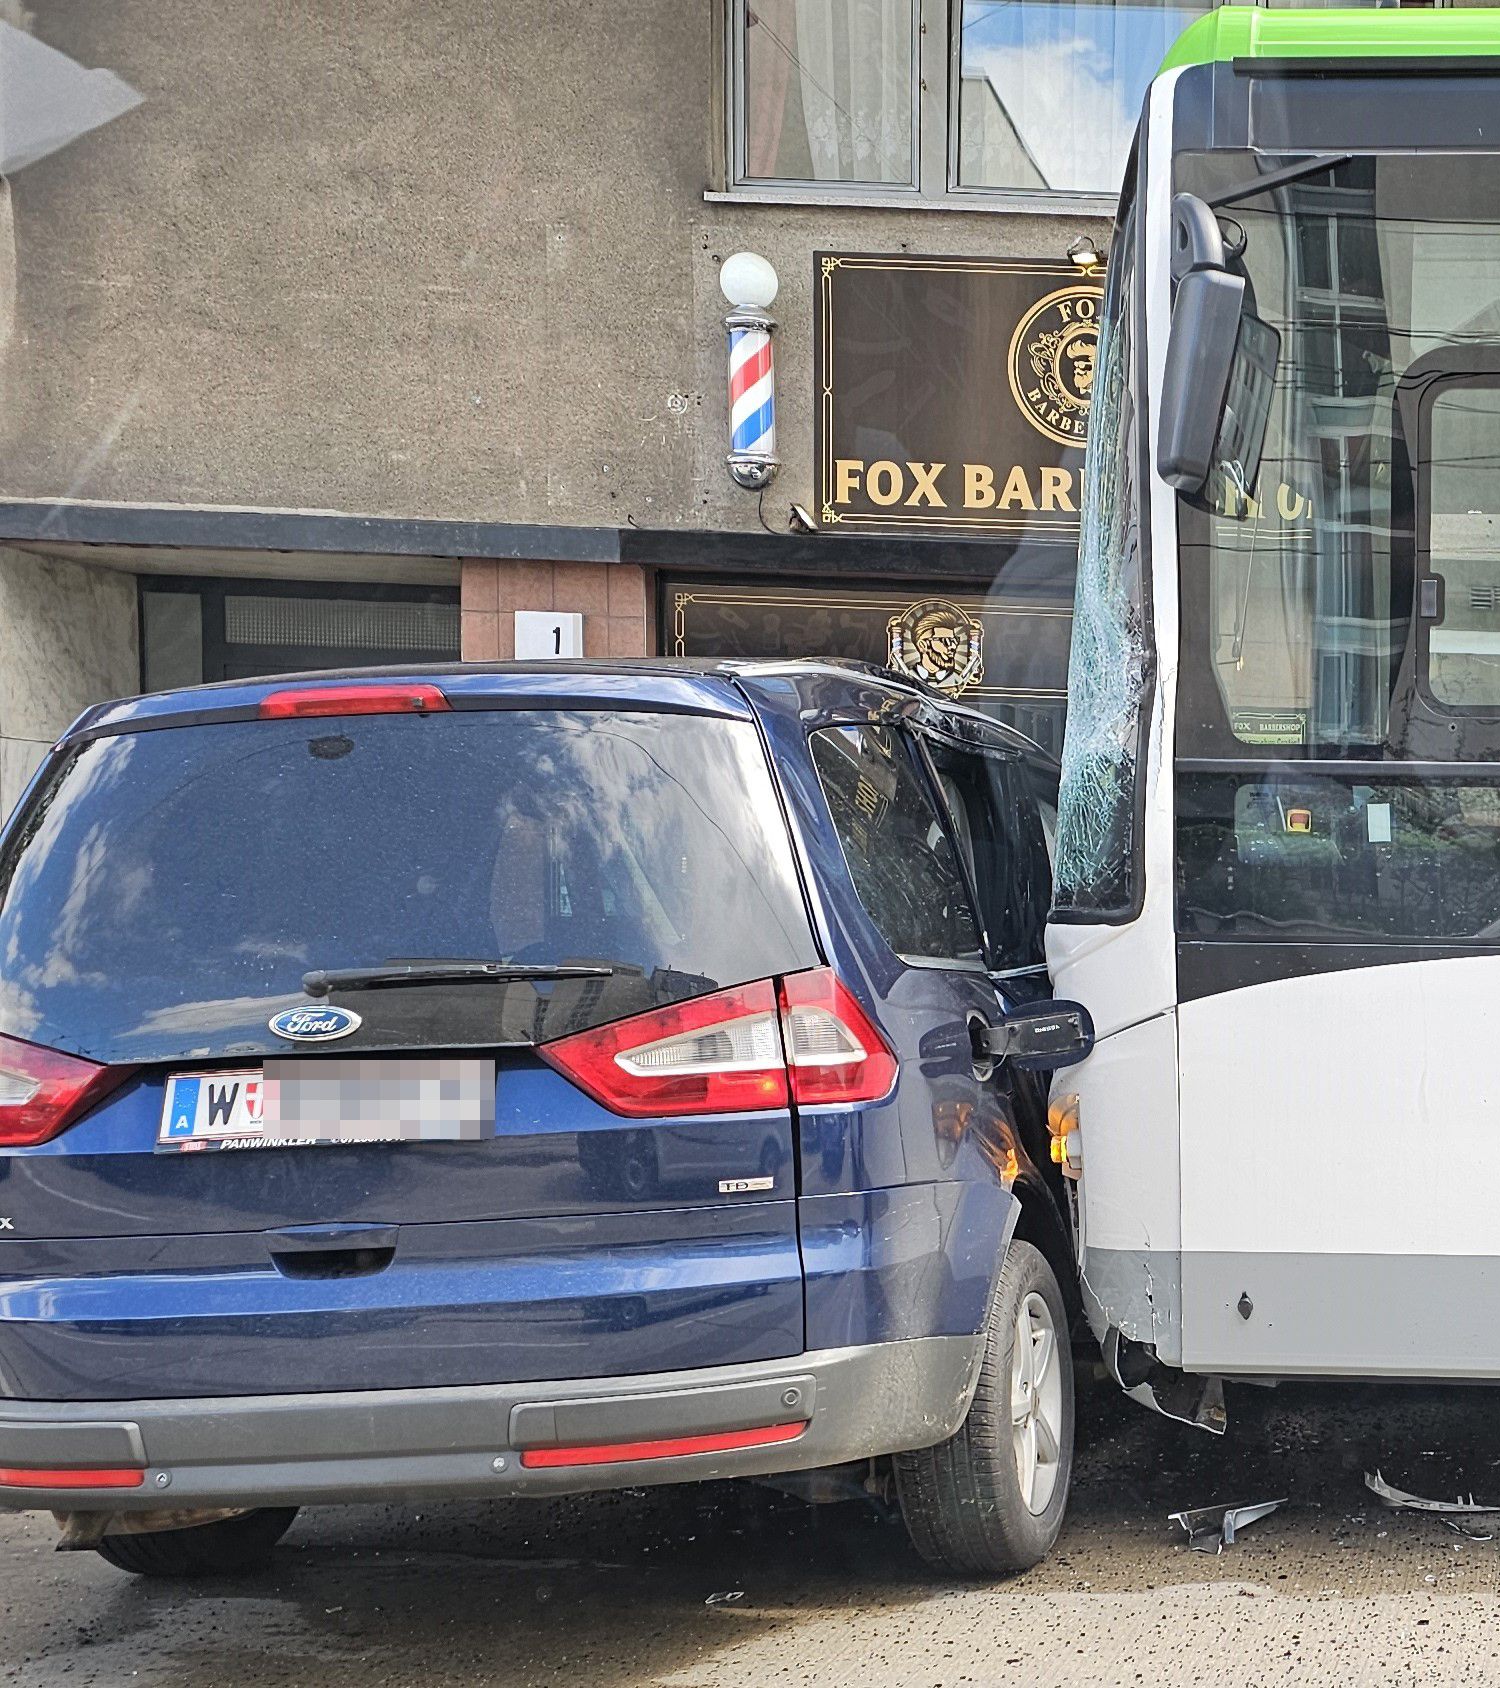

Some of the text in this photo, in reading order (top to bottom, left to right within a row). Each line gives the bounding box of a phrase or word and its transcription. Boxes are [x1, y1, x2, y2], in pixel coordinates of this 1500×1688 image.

[1056, 298, 1101, 323] FO
[834, 459, 1085, 513] FOX BAR
[552, 626, 561, 655] 1
[286, 1012, 339, 1033] Ford
[208, 1082, 240, 1127] W
[175, 1114, 190, 1129] A
